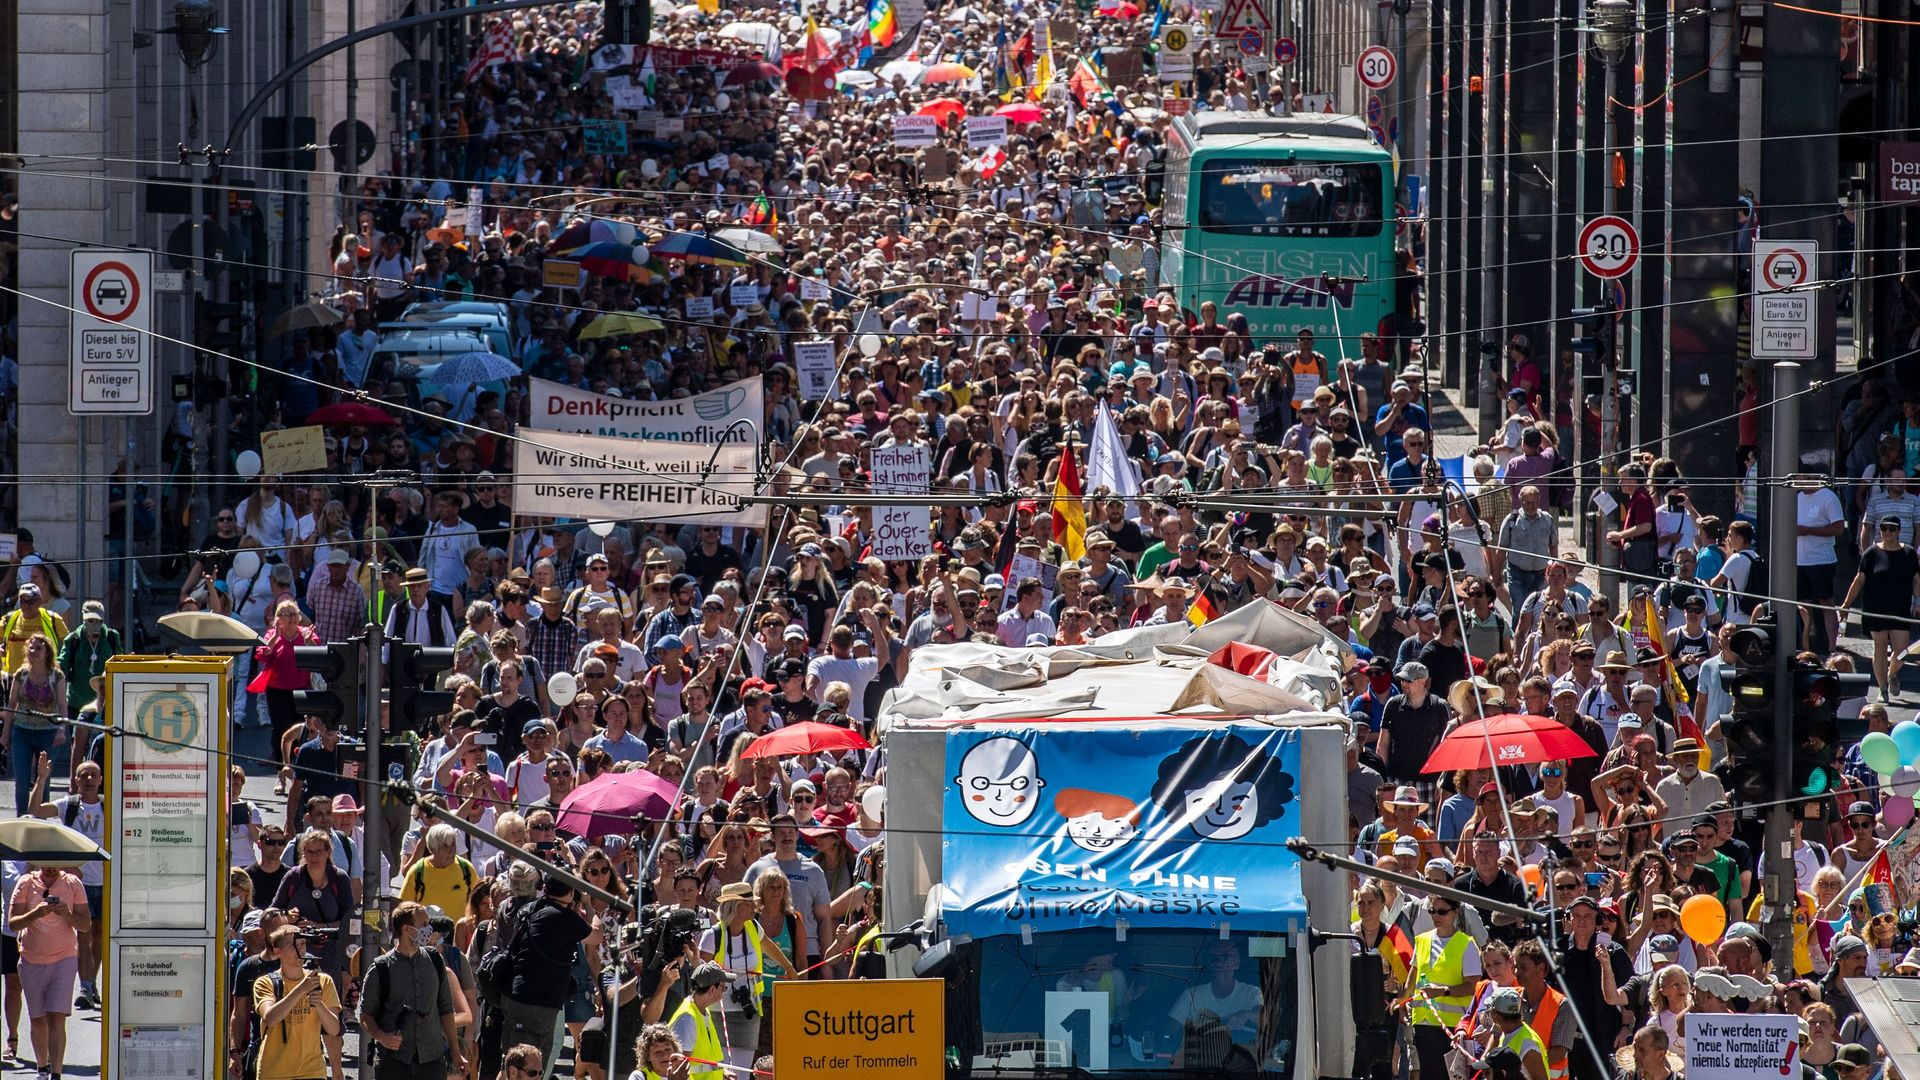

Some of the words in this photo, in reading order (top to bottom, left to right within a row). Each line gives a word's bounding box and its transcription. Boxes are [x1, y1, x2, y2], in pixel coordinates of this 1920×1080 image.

[1366, 58, 1388, 77] 30
[895, 117, 935, 127] CORONA
[1252, 226, 1329, 235] SETRA
[1592, 233, 1626, 261] 30
[1201, 250, 1377, 286] REISEN
[1222, 274, 1356, 310] AFAN
[1765, 300, 1790, 309] Diesel
[1791, 300, 1803, 309] bis
[1766, 311, 1786, 319] Euro
[1788, 311, 1802, 319] 5/V
[85, 333, 118, 345] Diesel
[121, 333, 137, 345] bis
[1766, 330, 1802, 341] Anlieger
[1777, 339, 1792, 348] frei
[87, 348, 112, 360] Euro
[116, 348, 135, 360] 5/V
[87, 373, 134, 387] Anlieger
[101, 387, 121, 399] frei
[535, 450, 566, 467] Wir
[569, 450, 607, 469] sind
[611, 455, 651, 472] laut,
[655, 460, 690, 473] weil
[871, 447, 923, 467] Freiheit
[873, 469, 888, 486] ist
[892, 469, 928, 484] immer
[535, 484, 594, 499] unsere
[599, 483, 697, 505] FREIHEIT
[701, 489, 741, 506] klau
[884, 506, 911, 523] der
[1682, 645, 1703, 655] NIKE
[153, 704, 182, 739] H
[132, 773, 144, 782] M1
[151, 772, 183, 780] Rosenthal,
[132, 801, 144, 810] M1
[133, 829, 142, 838] 12
[151, 828, 185, 836] Weißensee
[151, 836, 193, 844] Pasedagplatz
[1115, 894, 1241, 917] Maske
[803, 1009, 915, 1041] Stuttgart
[1697, 1022, 1719, 1037] Wir
[1721, 1023, 1762, 1038] werden
[1764, 1027, 1788, 1038] eure
[1060, 1008, 1091, 1068] 1
[803, 1055, 826, 1070] Ruf
[829, 1056, 850, 1069] der
[854, 1054, 917, 1069] Trommeln
[1692, 1054, 1731, 1068] niemals
